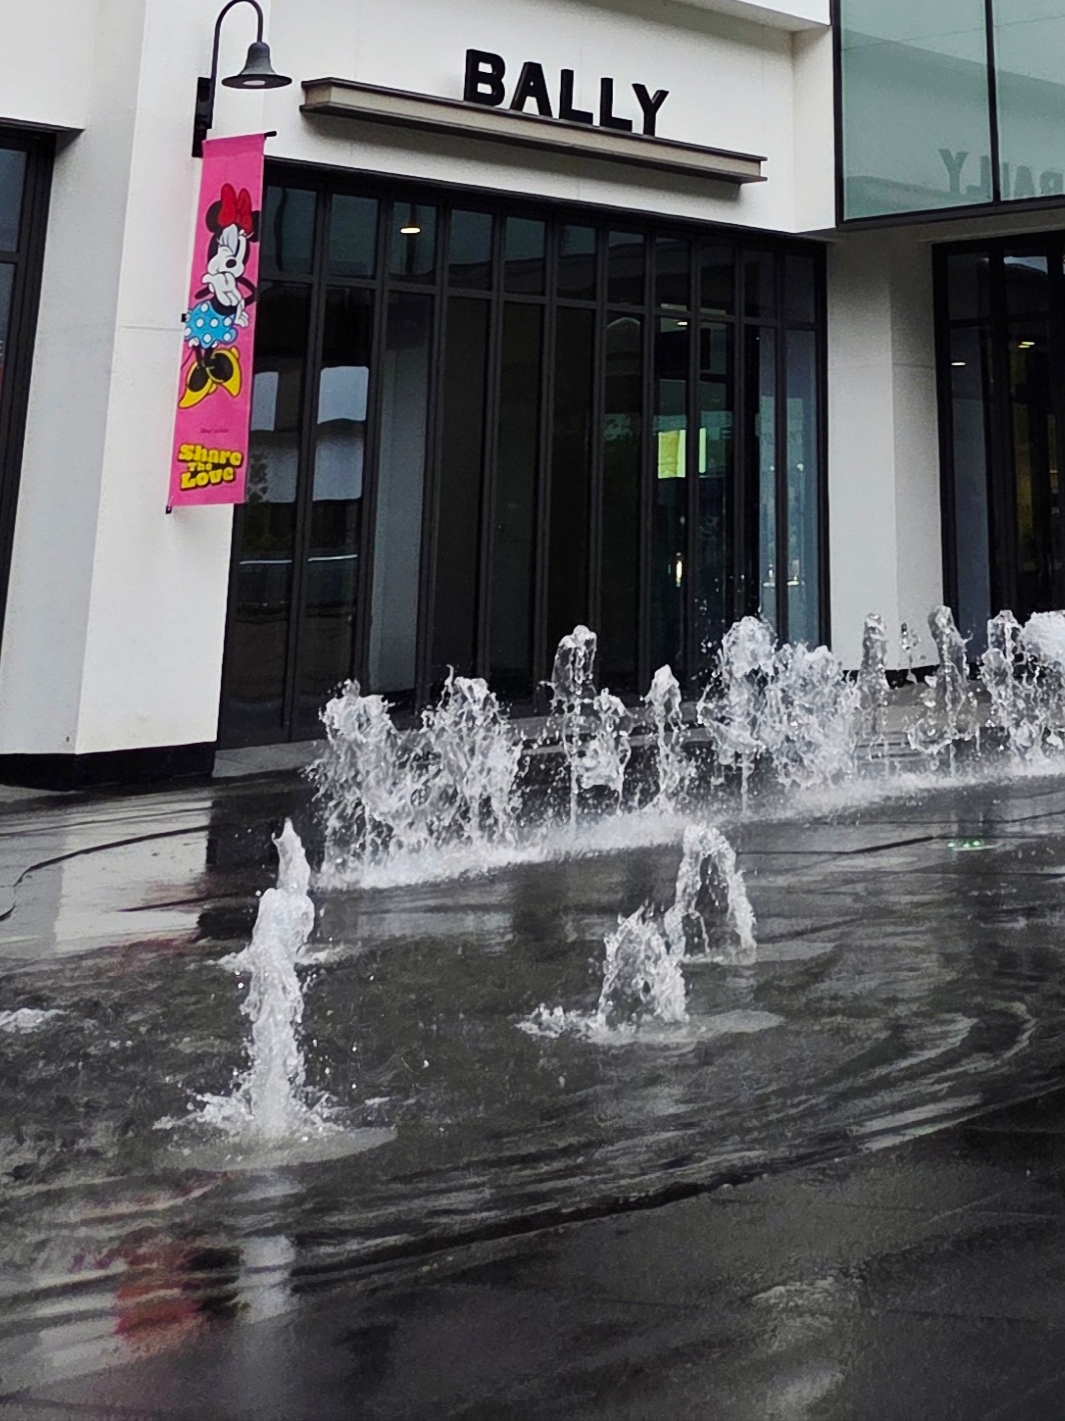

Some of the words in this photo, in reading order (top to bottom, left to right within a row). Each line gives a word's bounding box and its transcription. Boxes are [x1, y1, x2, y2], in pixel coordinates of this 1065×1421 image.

[463, 49, 669, 137] BALLY
[178, 443, 243, 467] Share
[187, 461, 213, 472] The
[180, 466, 235, 490] Love
